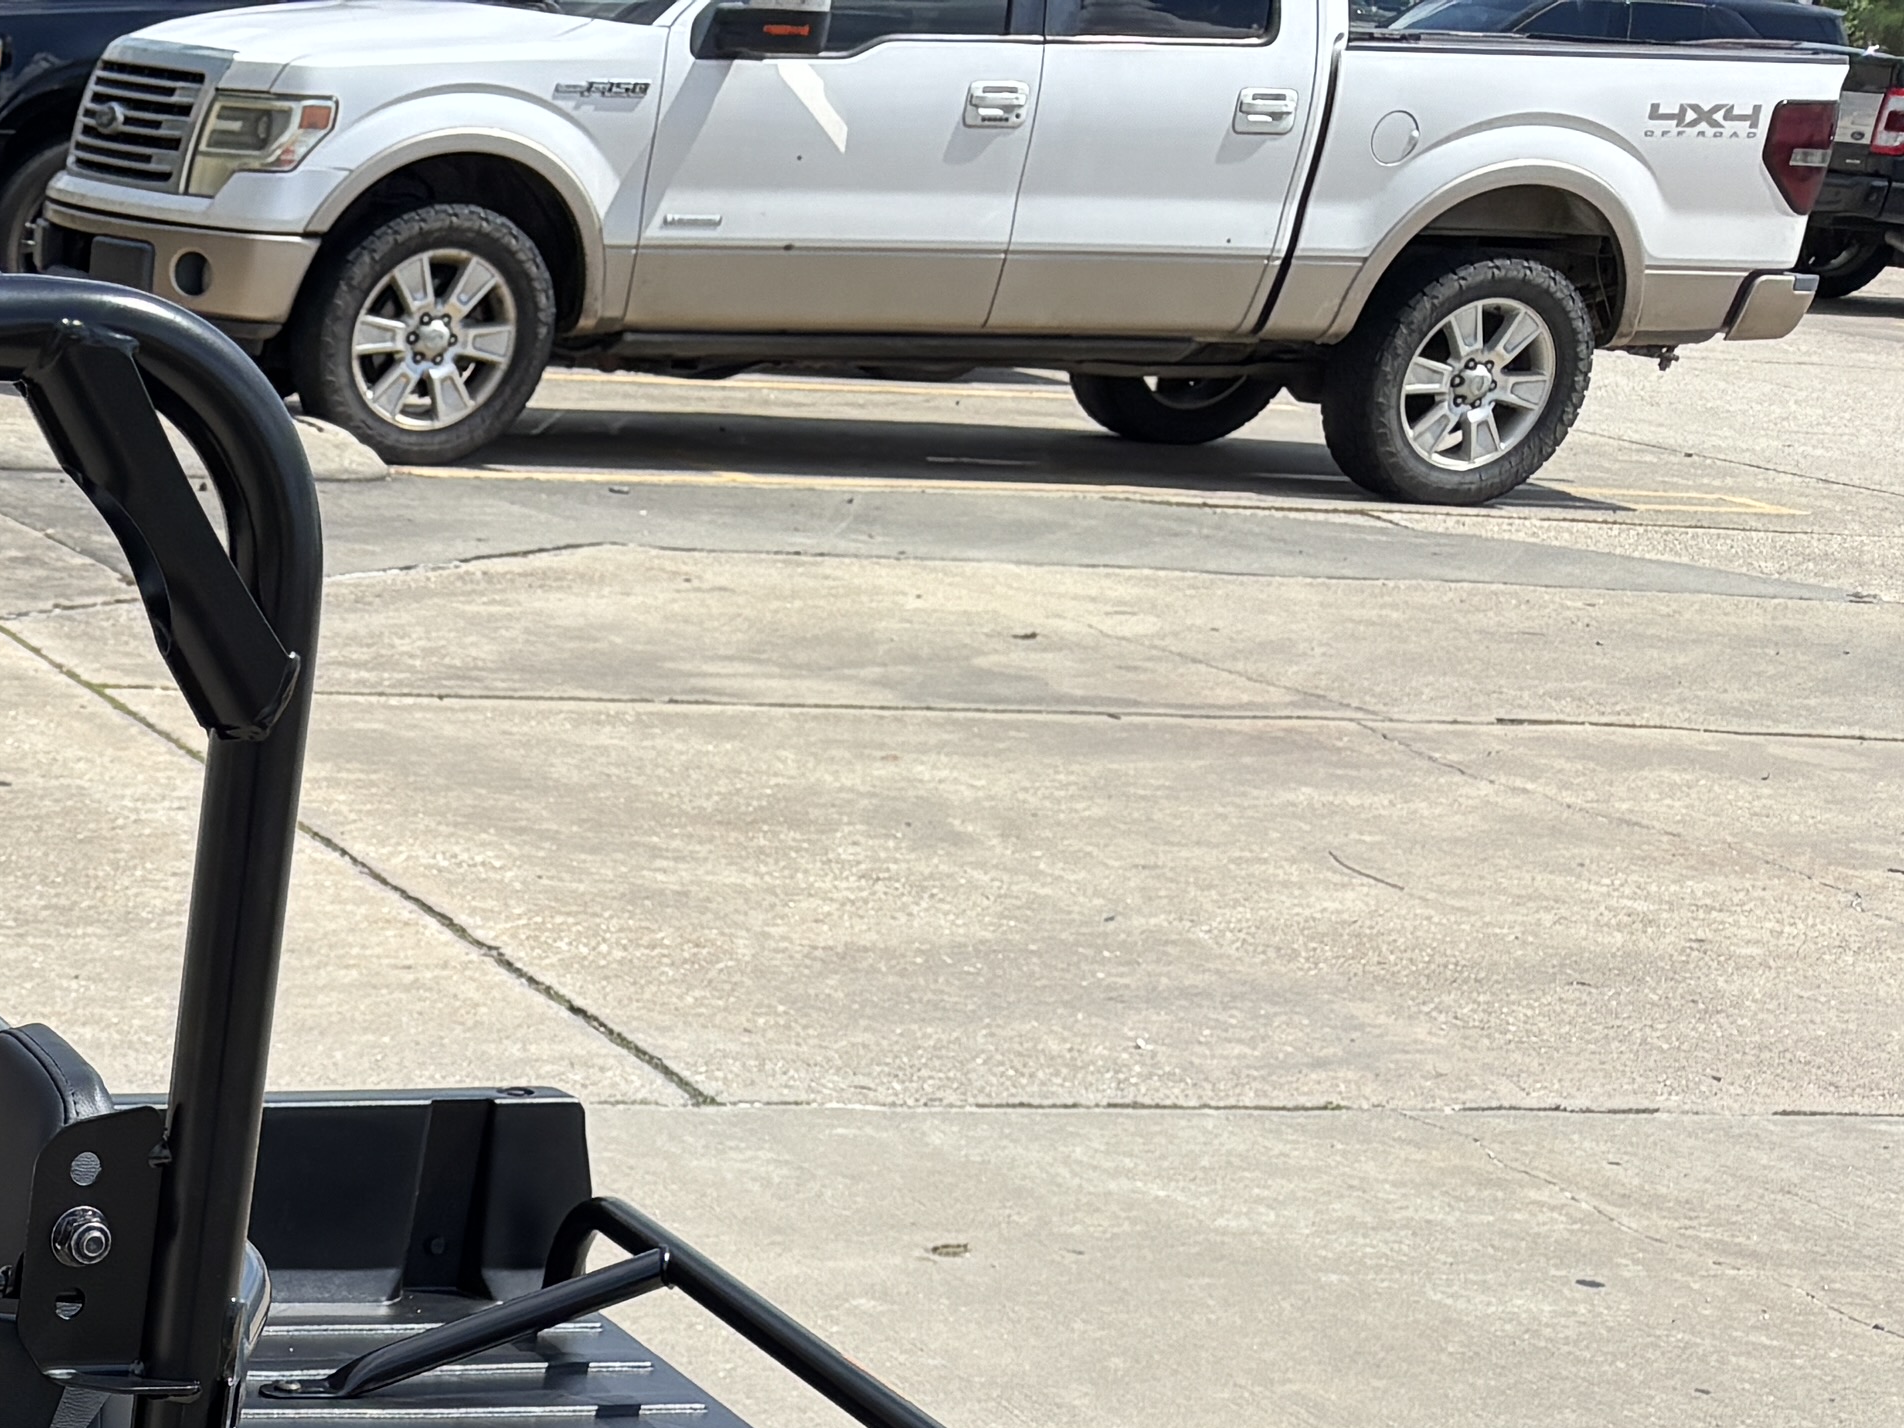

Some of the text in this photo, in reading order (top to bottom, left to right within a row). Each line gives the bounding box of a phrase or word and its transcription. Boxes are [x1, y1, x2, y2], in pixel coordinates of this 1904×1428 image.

[1647, 102, 1763, 130] 4X4
[1643, 129, 1758, 139] OFF ROAD
